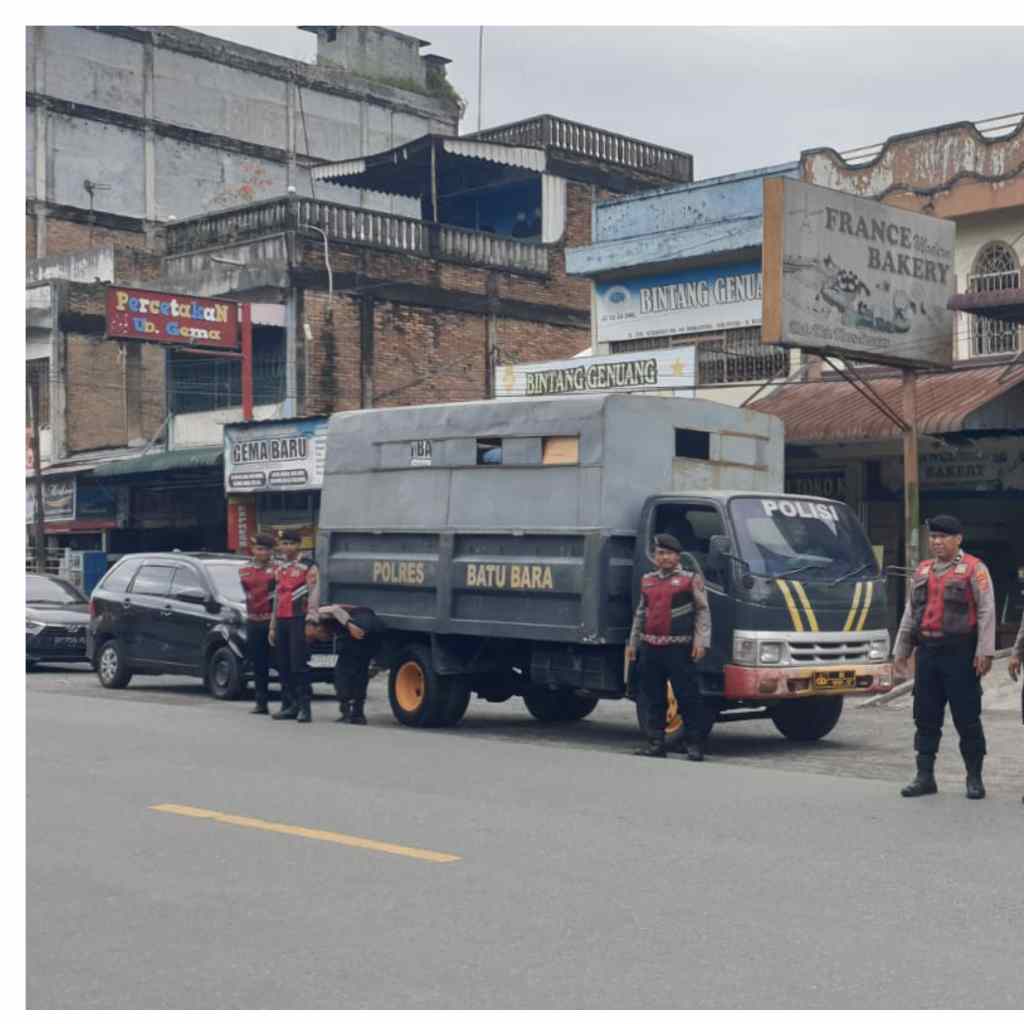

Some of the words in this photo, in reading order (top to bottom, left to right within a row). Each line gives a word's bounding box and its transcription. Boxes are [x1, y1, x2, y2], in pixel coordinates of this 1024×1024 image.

[825, 206, 912, 249] FRANCE
[867, 246, 951, 285] BAKERY
[639, 278, 710, 315] BINTANG
[527, 364, 585, 396] BINTANG
[586, 358, 657, 391] GENUANG
[233, 442, 267, 464] GEMA
[271, 438, 306, 459] BARU
[761, 499, 839, 521] POLISI
[373, 560, 425, 584] POLRES
[467, 563, 506, 587] BATU
[510, 563, 553, 589] BARA
